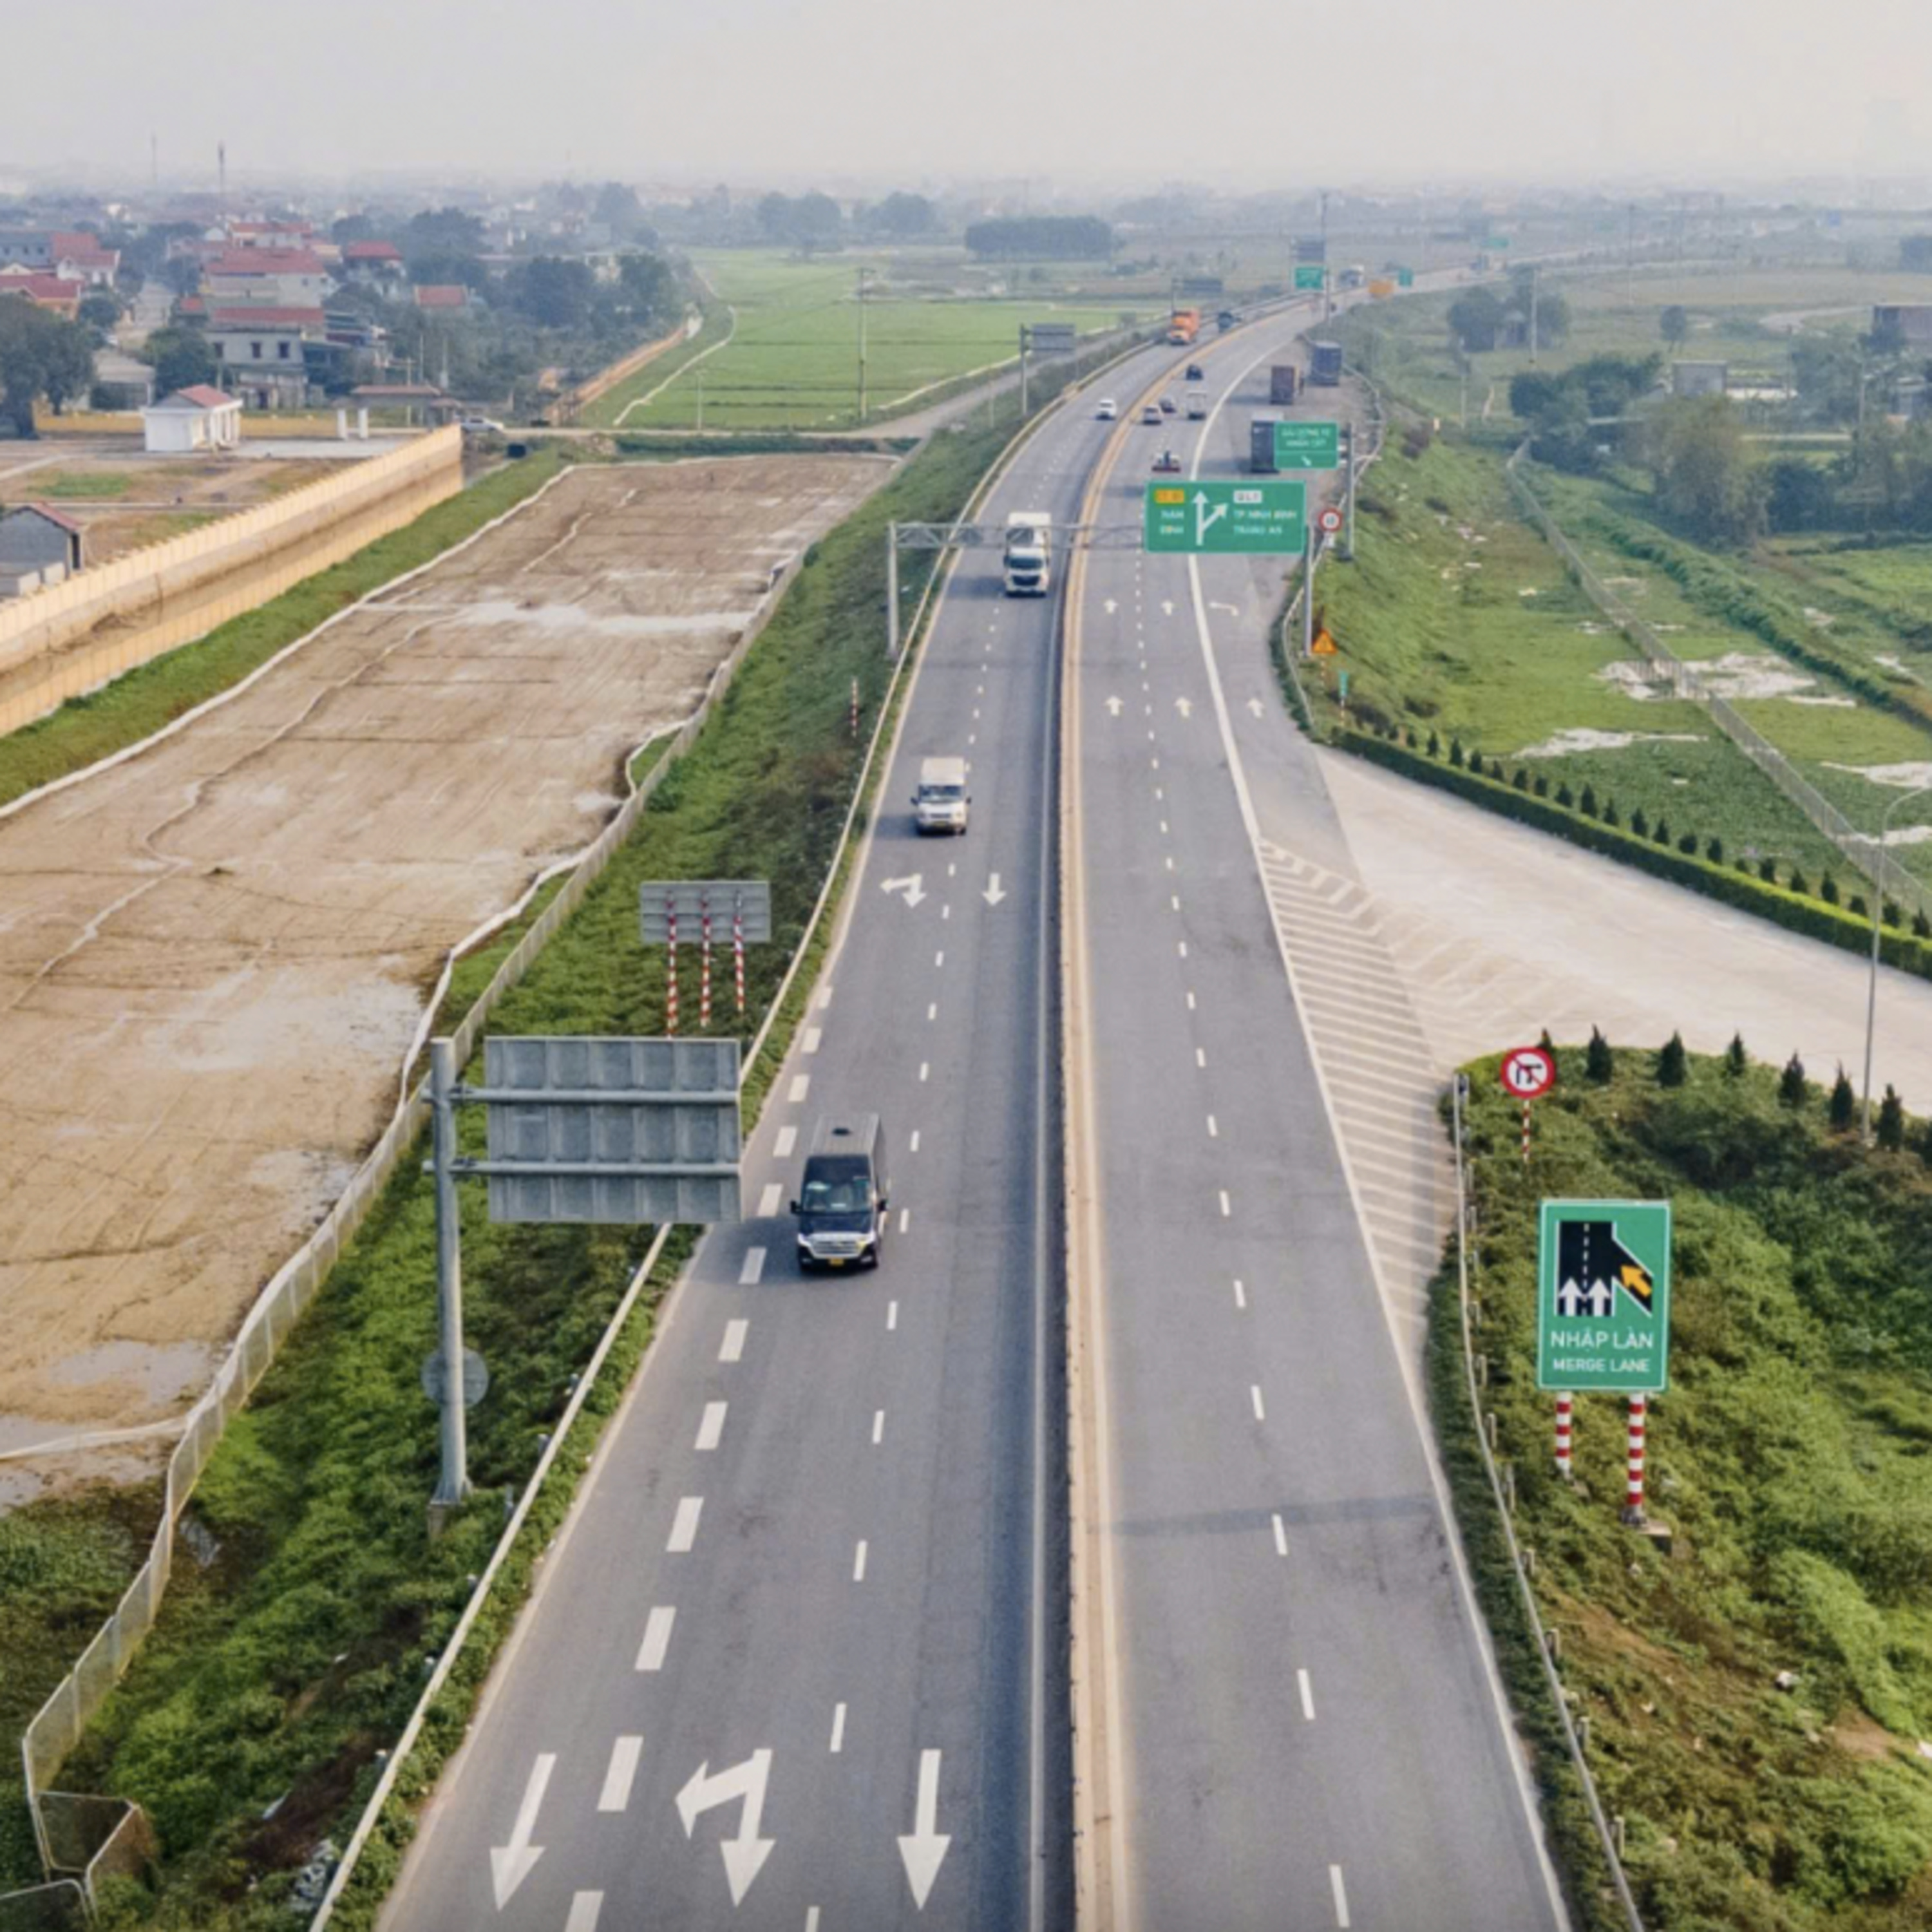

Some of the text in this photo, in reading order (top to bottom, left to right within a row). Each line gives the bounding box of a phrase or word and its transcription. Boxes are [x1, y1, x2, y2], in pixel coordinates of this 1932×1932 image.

[1613, 1325, 1653, 1350] LÀN
[1553, 1358, 1650, 1372] MERGE LANE
